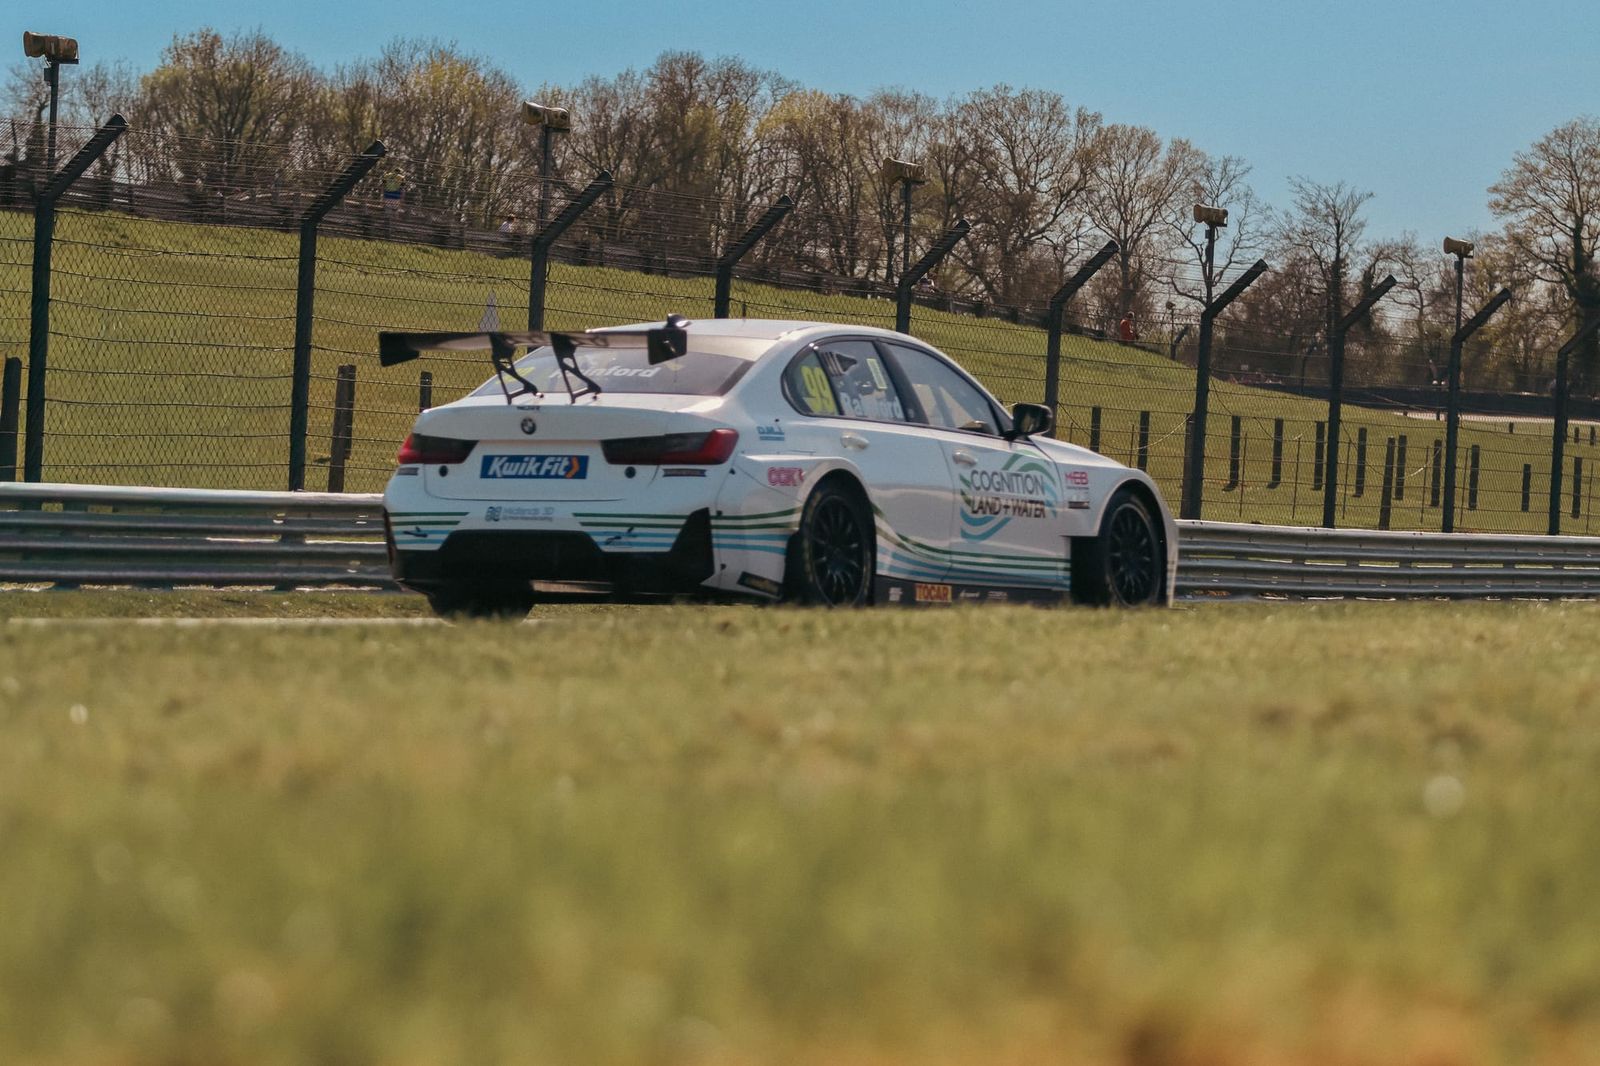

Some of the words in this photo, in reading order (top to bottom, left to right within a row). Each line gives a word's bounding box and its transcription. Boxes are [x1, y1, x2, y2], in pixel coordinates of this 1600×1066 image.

[970, 470, 1046, 496] COGNITION
[971, 496, 1001, 515] LAND
[1011, 498, 1046, 519] WATER
